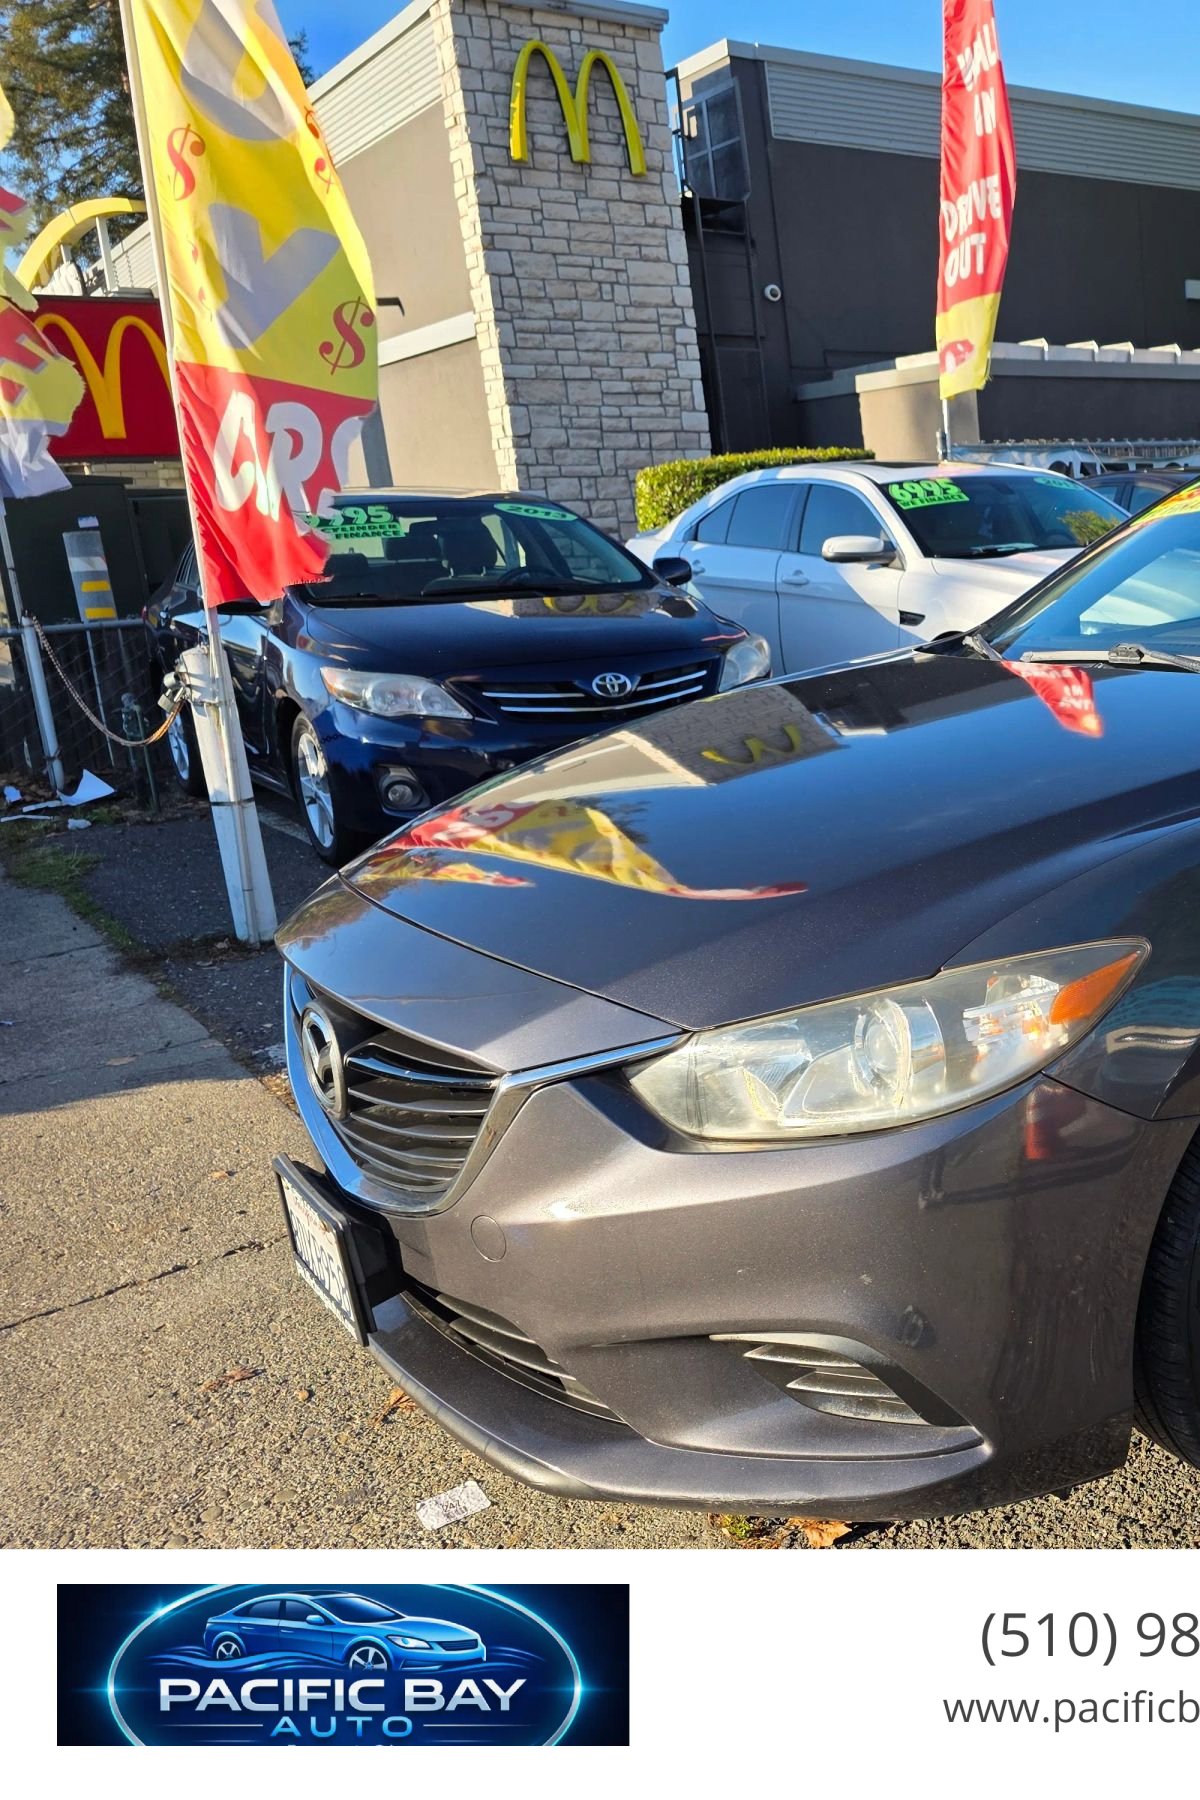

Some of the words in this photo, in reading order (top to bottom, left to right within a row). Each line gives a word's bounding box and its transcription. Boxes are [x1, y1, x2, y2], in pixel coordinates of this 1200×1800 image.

[974, 86, 996, 137] IN
[941, 173, 1001, 242] DRIVE
[944, 232, 987, 288] OUT
[889, 477, 961, 501] 6995
[334, 530, 401, 539] FINANCE
